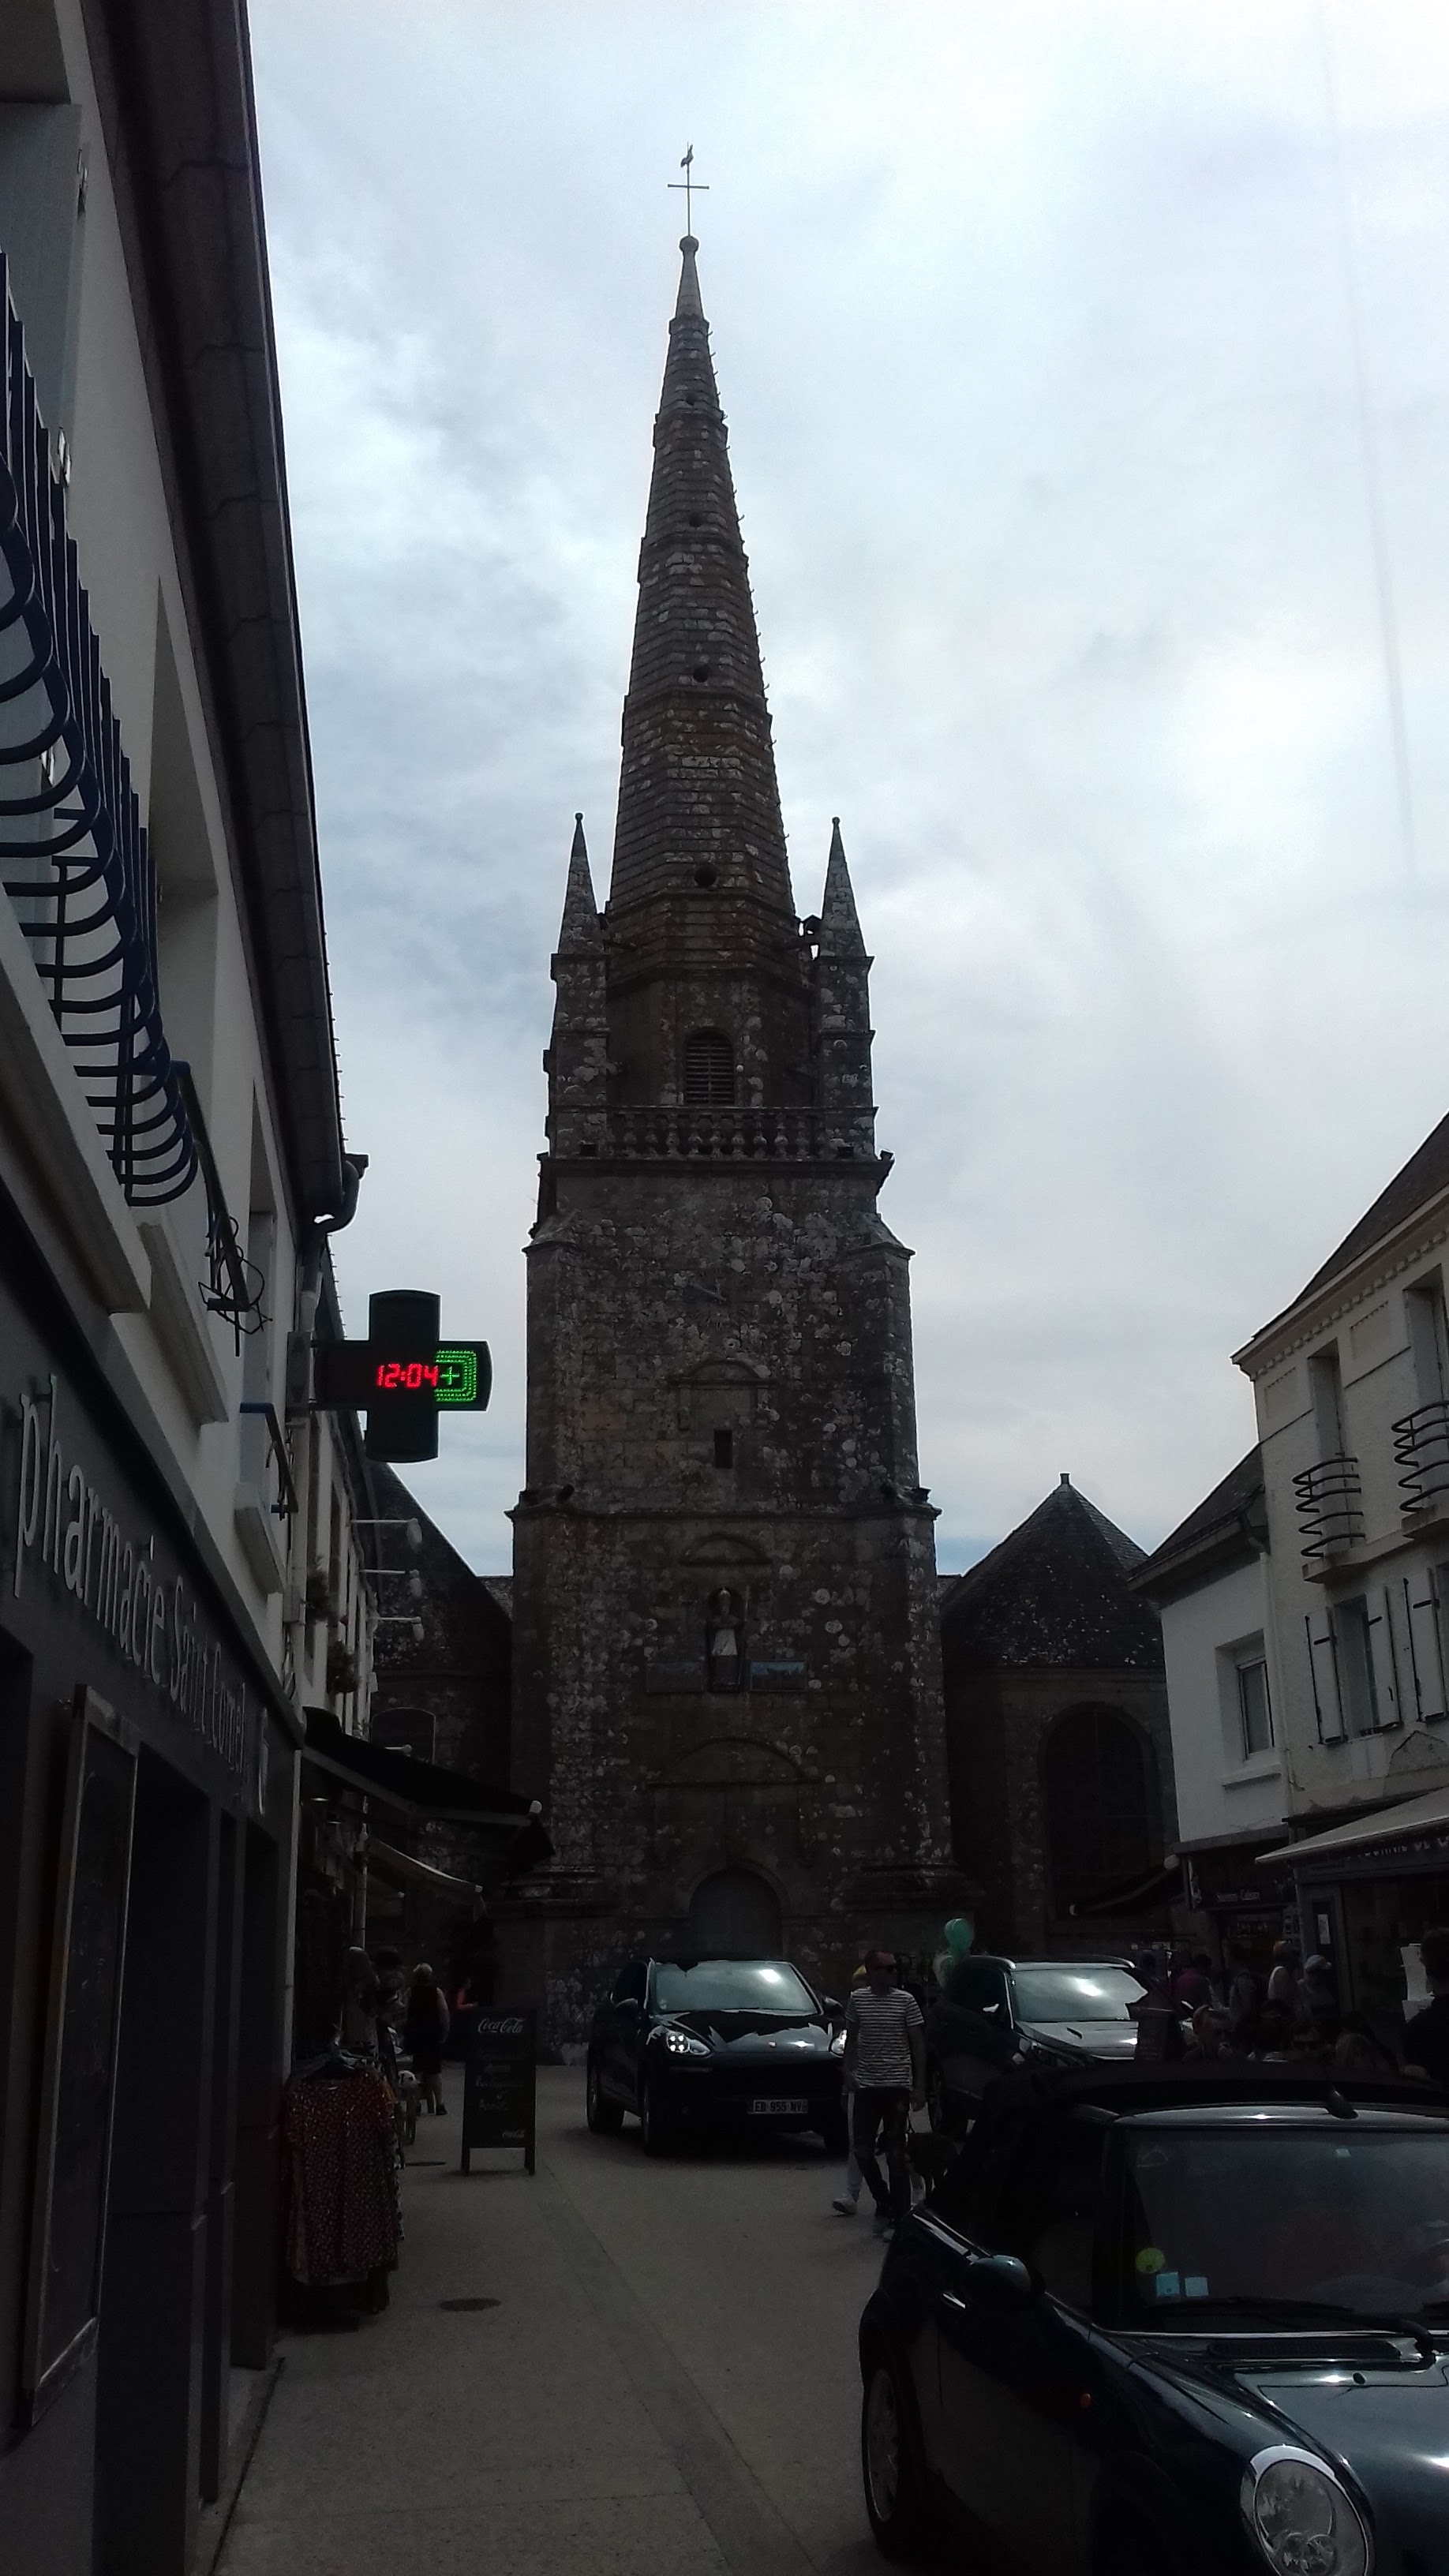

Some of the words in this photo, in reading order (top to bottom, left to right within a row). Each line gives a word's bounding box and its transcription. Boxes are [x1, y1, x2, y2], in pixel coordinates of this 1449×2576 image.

[376, 1363, 439, 1389] 12:04
[169, 1574, 208, 1735] Saint
[477, 2016, 526, 2034] CocaCola
[770, 2101, 787, 2112] 955
